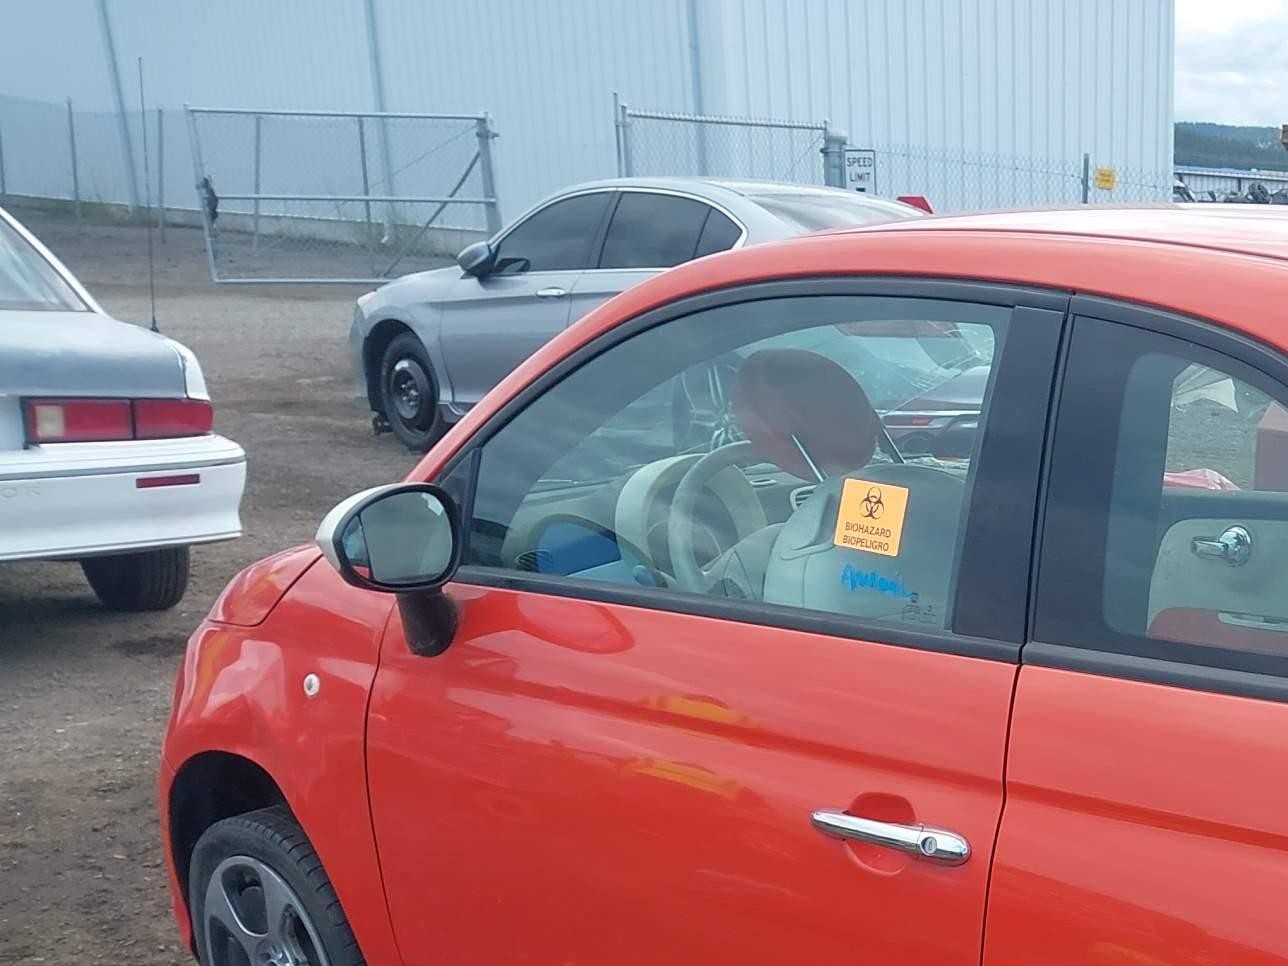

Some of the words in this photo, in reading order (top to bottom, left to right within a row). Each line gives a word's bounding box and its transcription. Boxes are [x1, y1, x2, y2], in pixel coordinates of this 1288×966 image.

[847, 157, 873, 167] SPEED
[849, 172, 871, 182] LIMIT
[845, 521, 892, 538] BIOHAZARD
[842, 534, 890, 552] BIOPELIGRO
